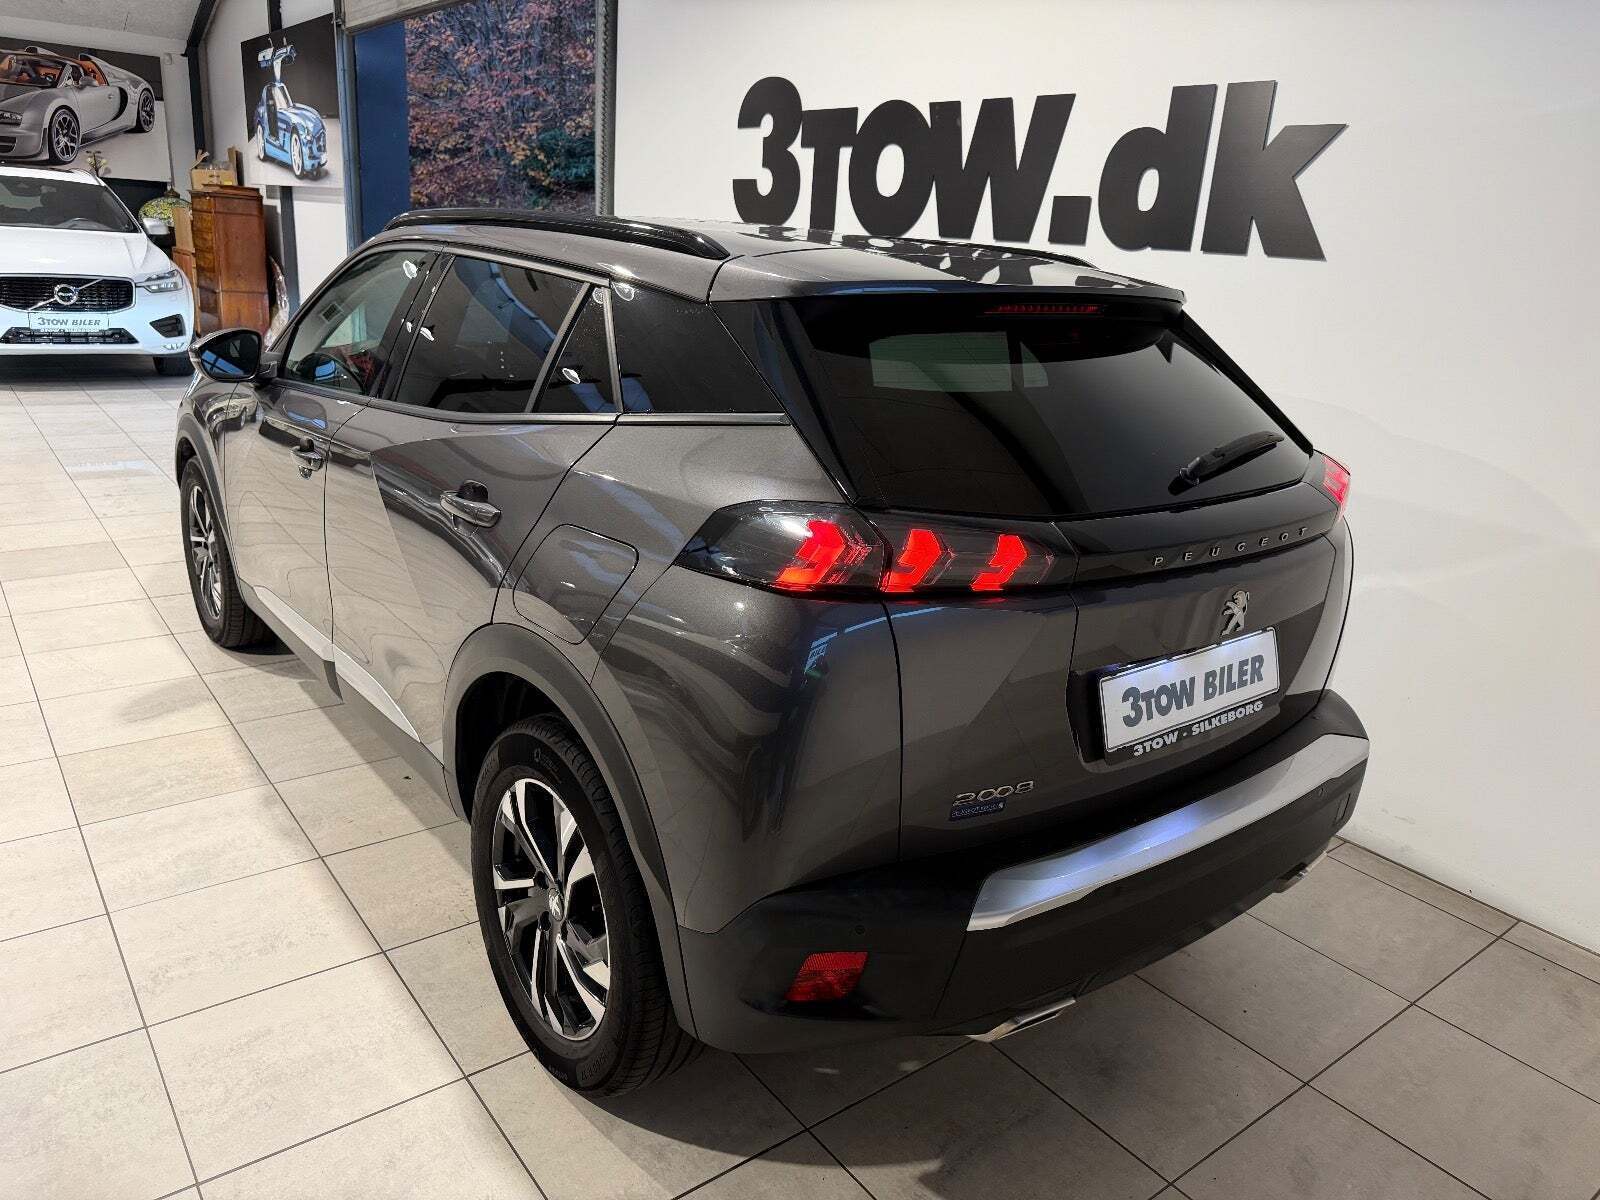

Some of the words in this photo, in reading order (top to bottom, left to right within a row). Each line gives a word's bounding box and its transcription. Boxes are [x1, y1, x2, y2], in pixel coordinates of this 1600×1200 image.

[732, 76, 1348, 262] 3TOW.dk
[1154, 527, 1308, 567] PEUGEOT
[1121, 676, 1196, 728] 3TOW
[1203, 654, 1265, 702] BILER
[1133, 730, 1179, 757] 3TOW
[1191, 700, 1264, 736] SILKEBORG
[952, 780, 1034, 807] 2008
